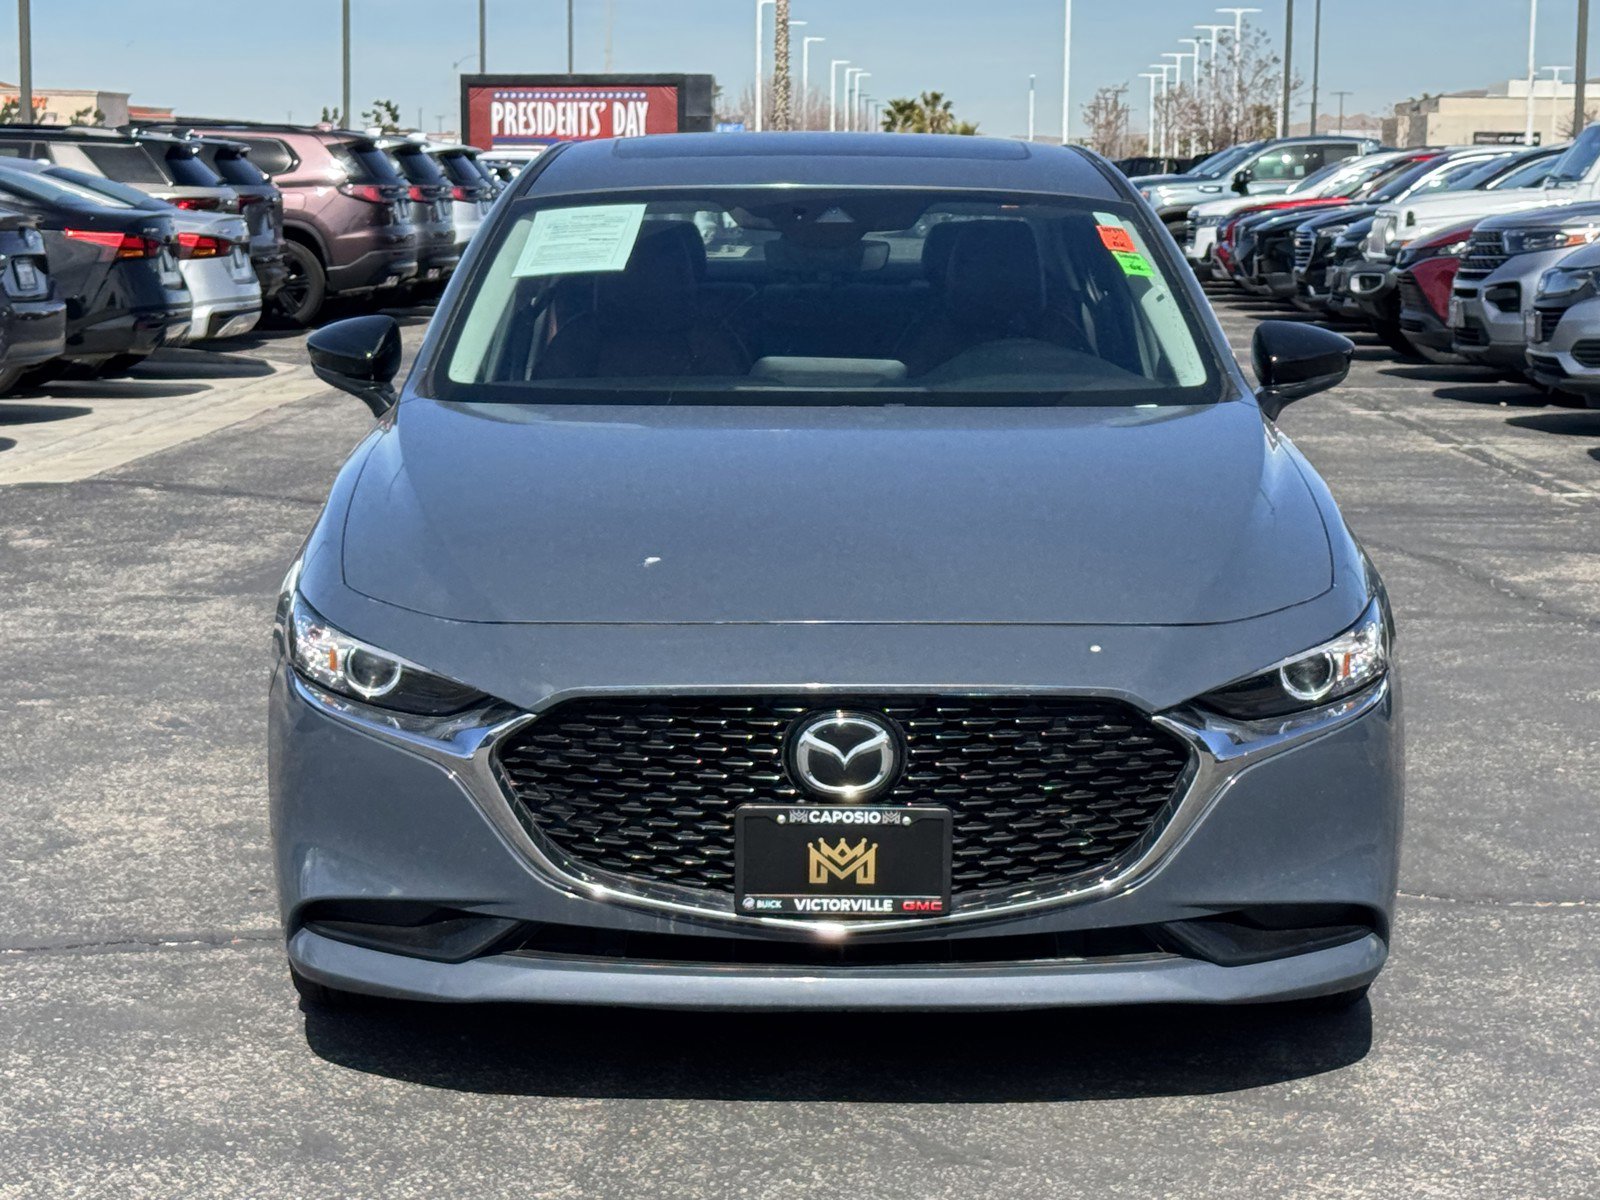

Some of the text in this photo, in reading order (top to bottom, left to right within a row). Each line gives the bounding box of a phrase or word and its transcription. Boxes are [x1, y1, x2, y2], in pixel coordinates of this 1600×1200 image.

[612, 101, 649, 137] DAY
[808, 810, 882, 824] CAPOSIO
[756, 899, 943, 912] BUICK VICTORVILLE GMC
